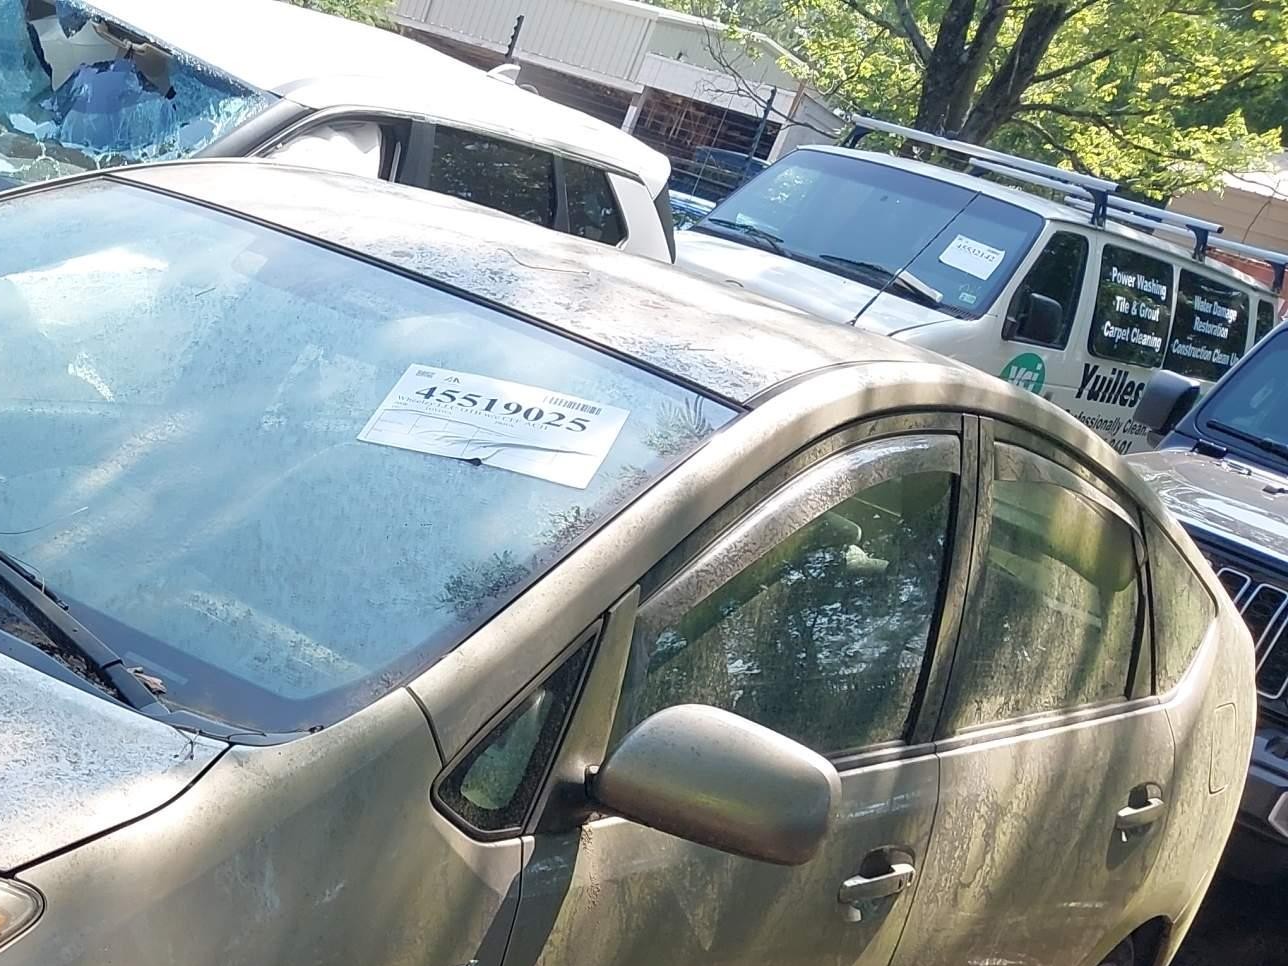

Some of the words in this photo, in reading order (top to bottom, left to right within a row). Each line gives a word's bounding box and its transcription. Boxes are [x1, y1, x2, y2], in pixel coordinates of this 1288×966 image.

[1112, 266, 1136, 288] Power
[1137, 274, 1167, 301] Washing
[1115, 295, 1130, 314] Tile
[1131, 300, 1138, 315] &
[1139, 302, 1160, 322] Grout
[1194, 295, 1212, 313] Water
[1212, 301, 1238, 323] Damage
[1103, 320, 1130, 343] Carpet
[1131, 327, 1162, 353] Cleaning
[1193, 316, 1229, 339] Restoration
[1172, 338, 1212, 361] Construction
[1212, 348, 1230, 365] Clean
[1075, 363, 1146, 408] Yuilles
[415, 386, 591, 433] 45519025
